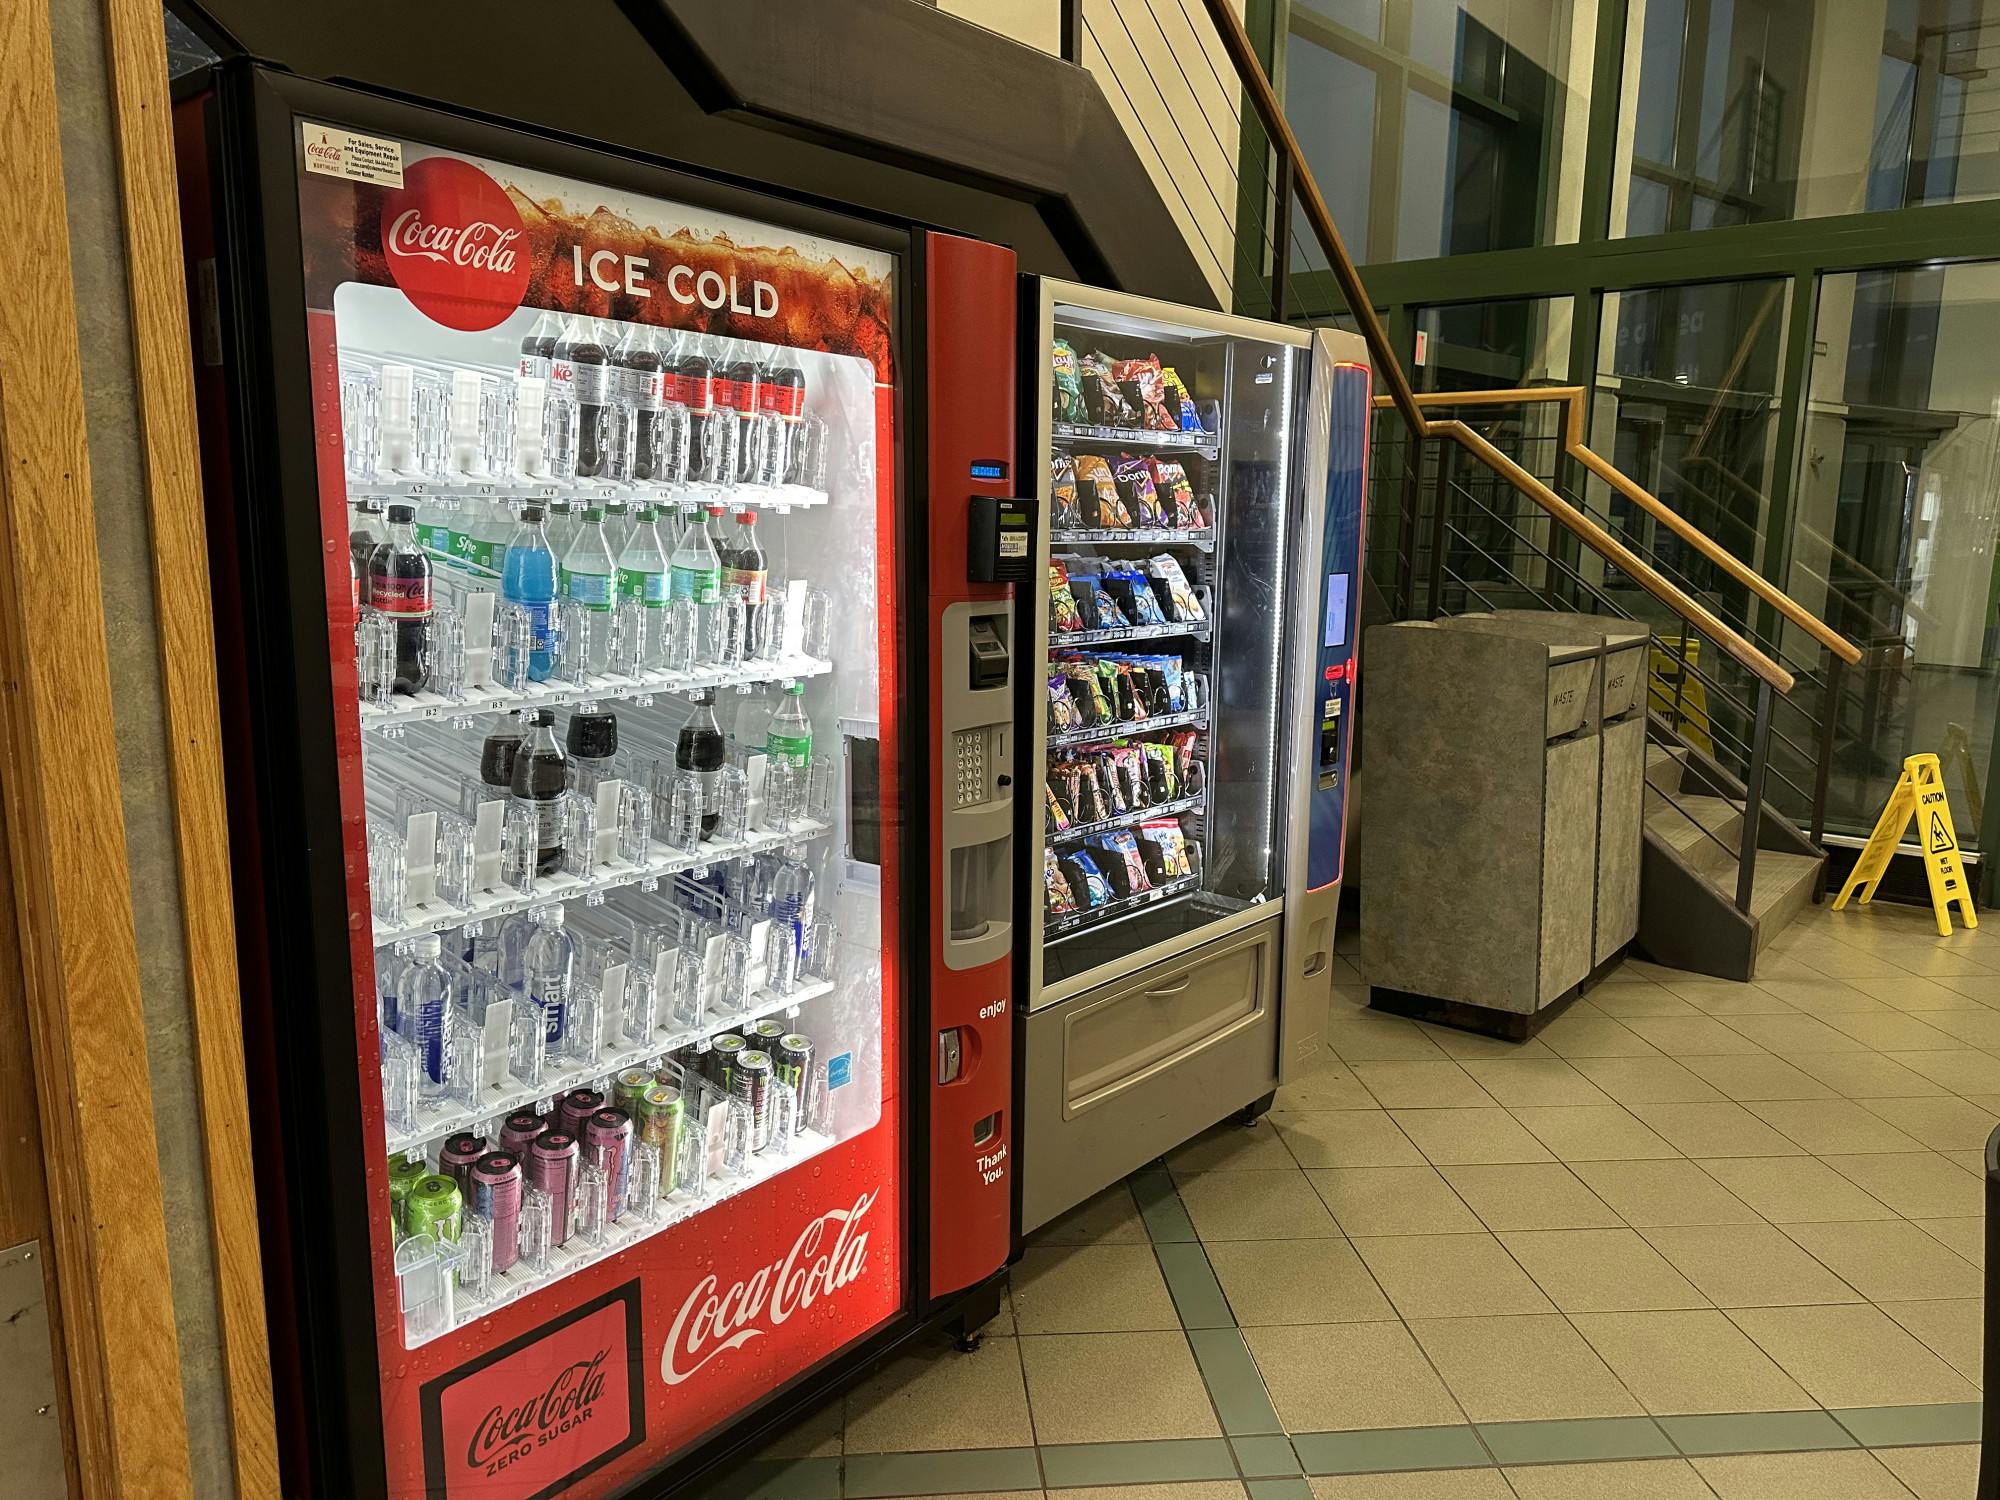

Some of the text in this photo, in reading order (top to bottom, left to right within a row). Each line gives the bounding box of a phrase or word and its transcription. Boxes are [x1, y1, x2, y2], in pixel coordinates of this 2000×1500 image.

[343, 145, 400, 162] and Equipment Repair
[348, 137, 394, 154] For Sales, Service
[388, 209, 522, 273] Coca-Cola
[573, 245, 780, 319] ICE COLD
[479, 486, 492, 494] A3
[543, 488, 554, 496] A4
[601, 489, 612, 497] A5
[1607, 675, 1625, 689] WASTE
[1553, 690, 1575, 706] WASTE
[425, 708, 437, 717] B2
[492, 701, 504, 709] B3
[1922, 791, 1945, 805] CAUTION
[433, 920, 446, 930] C2
[501, 905, 513, 914] C3
[562, 890, 573, 898] C4
[618, 876, 628, 884] C5
[544, 975, 562, 1035] smart
[979, 998, 1007, 1019] enjoy
[568, 1079, 579, 1087] D4
[976, 1144, 1007, 1172] Thank
[983, 1166, 1004, 1185] You.
[661, 1185, 880, 1385] Coca-Cola
[468, 1345, 613, 1468] Coca-Cola
[486, 1408, 593, 1477] ZERO SUGAR
